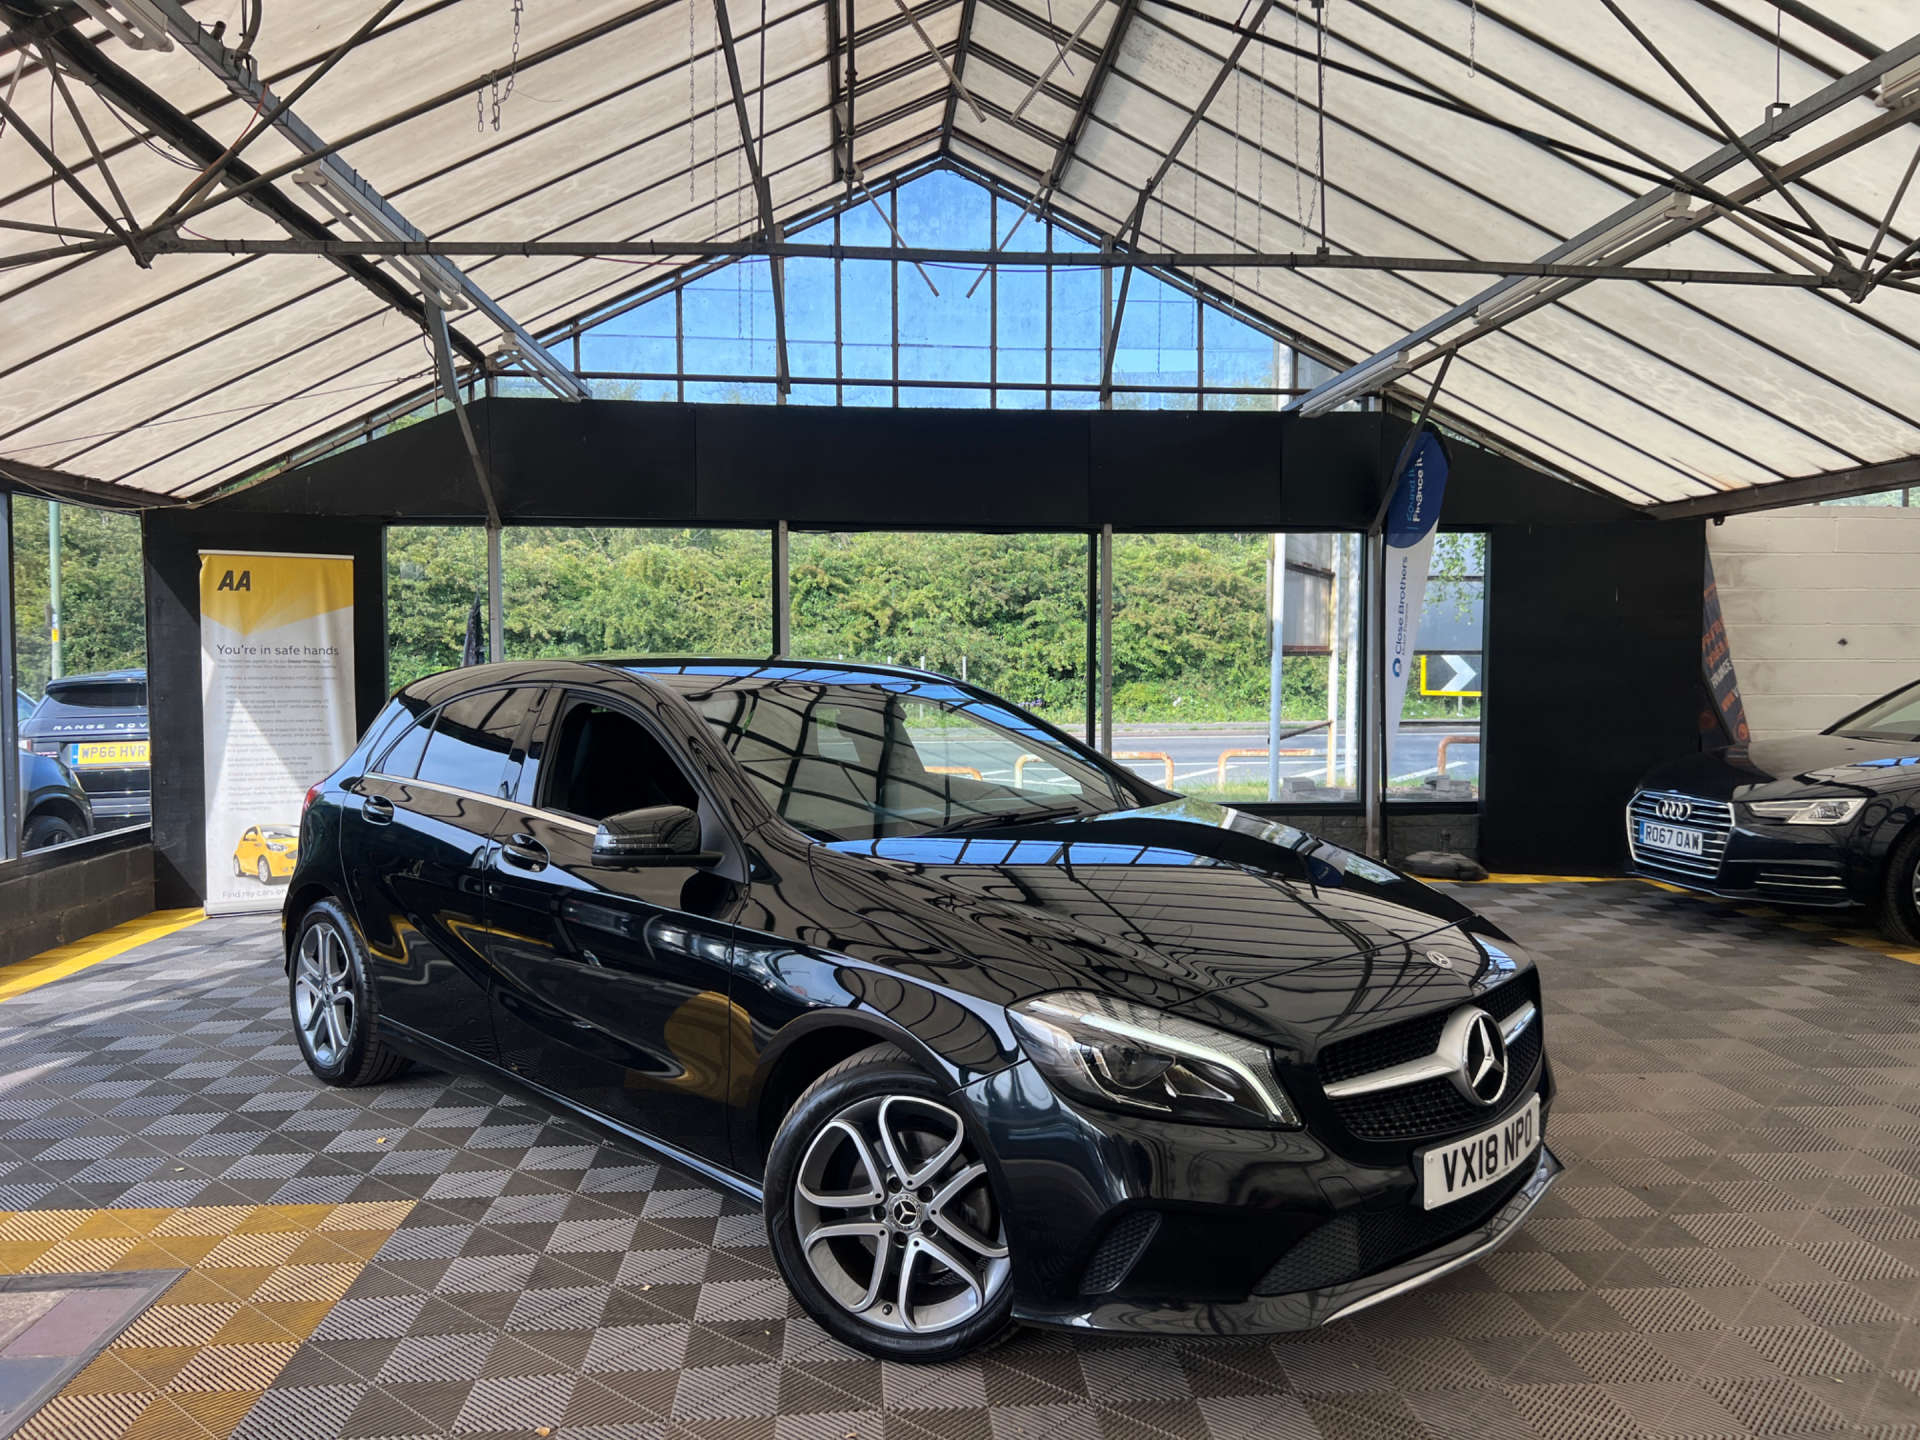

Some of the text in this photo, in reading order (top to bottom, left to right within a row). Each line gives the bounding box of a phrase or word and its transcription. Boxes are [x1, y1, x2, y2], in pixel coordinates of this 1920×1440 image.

[1413, 469, 1424, 521] Finance
[217, 570, 251, 592] AA
[1395, 556, 1409, 655] Close Brothers
[216, 644, 339, 656] You're in safe hands
[80, 744, 147, 759] WP66 HVR
[1442, 1108, 1532, 1193] VX18 NPO
